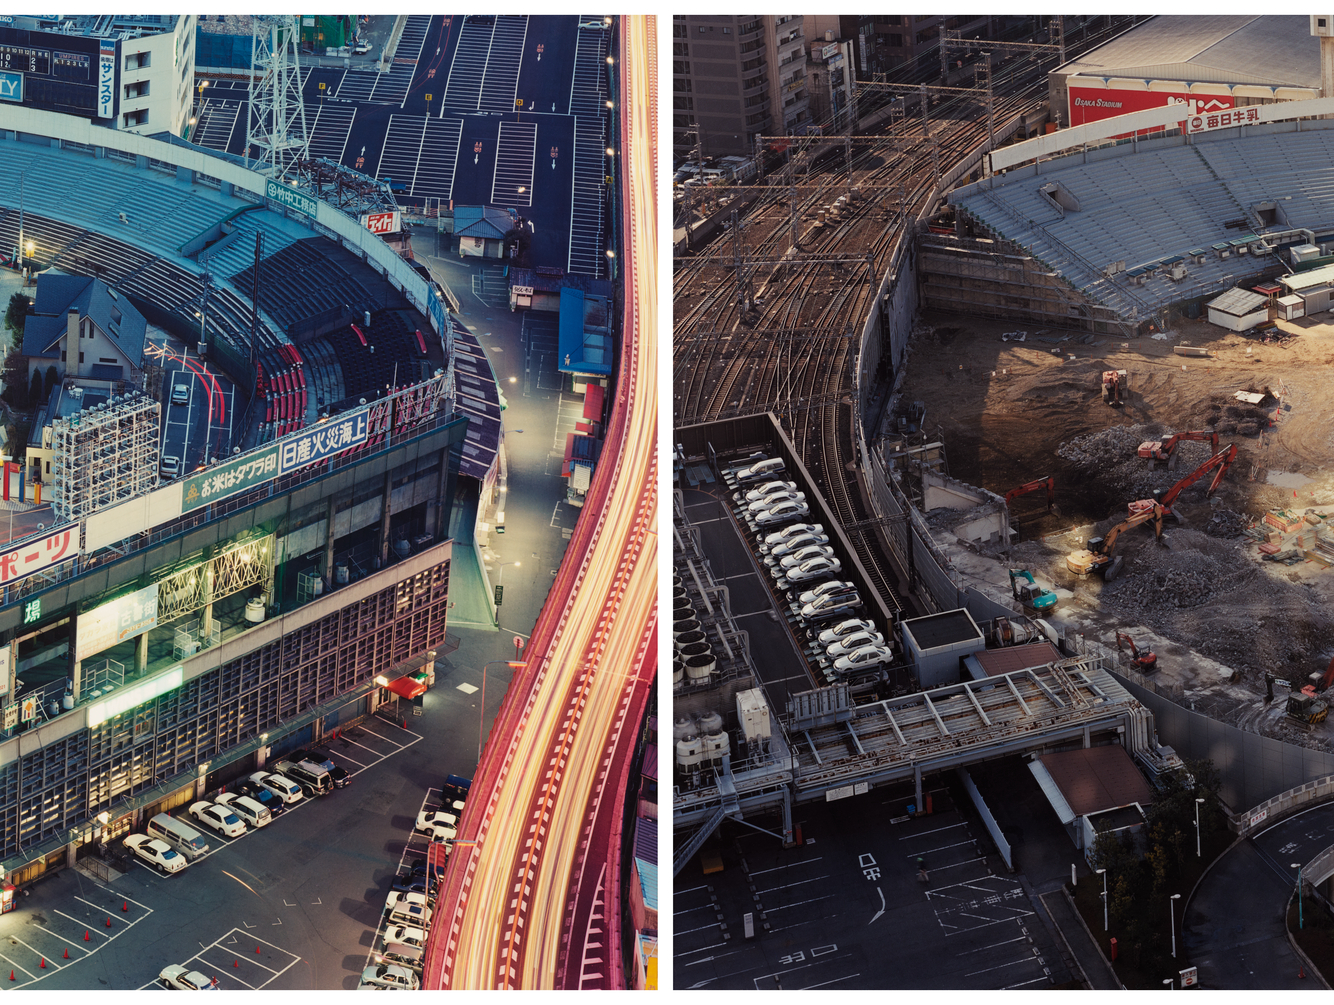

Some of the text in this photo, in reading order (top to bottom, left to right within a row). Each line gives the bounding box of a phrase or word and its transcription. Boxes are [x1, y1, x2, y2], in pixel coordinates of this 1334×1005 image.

[101, 63, 112, 115] サンスター
[1074, 98, 1123, 108] OSAKA STADIUM
[1207, 108, 1259, 129] 毎日牛乳
[277, 187, 317, 216] 竹中工務店
[282, 416, 366, 468] 日産火災海上
[201, 453, 277, 497] お米はタワラ印
